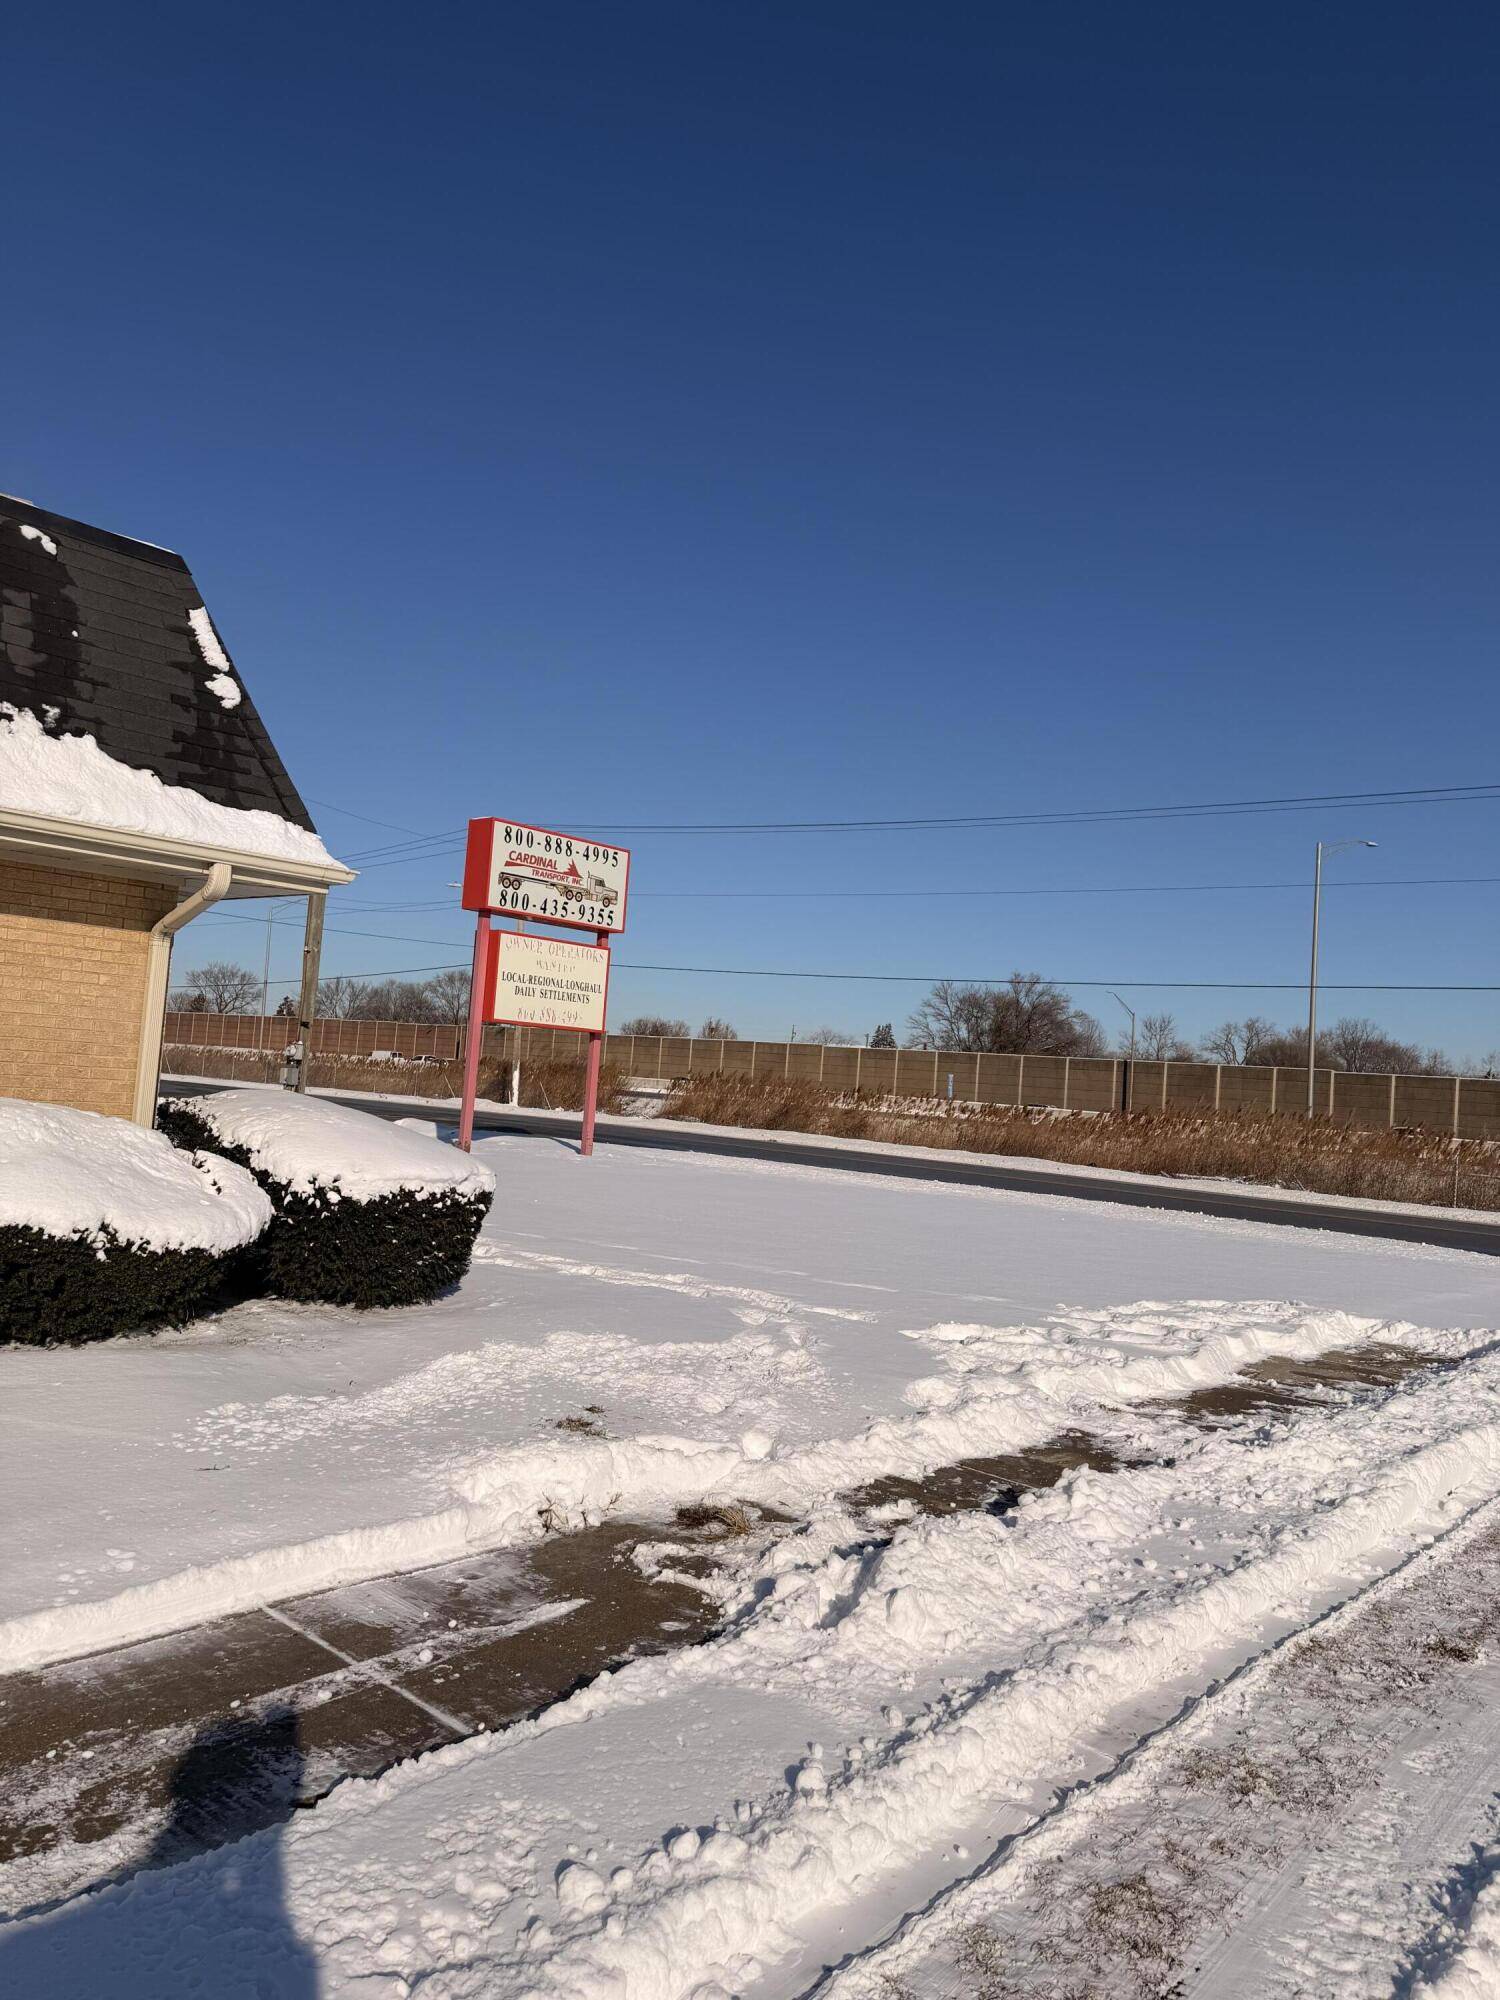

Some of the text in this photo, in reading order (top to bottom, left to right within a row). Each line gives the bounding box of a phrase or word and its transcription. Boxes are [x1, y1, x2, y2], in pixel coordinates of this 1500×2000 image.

[504, 825, 619, 868] 800-888-4995
[508, 850, 558, 869] CARDINAL
[499, 889, 615, 927] 800-435-9355
[514, 985, 590, 1005] DAILY SETTLEMENTS
